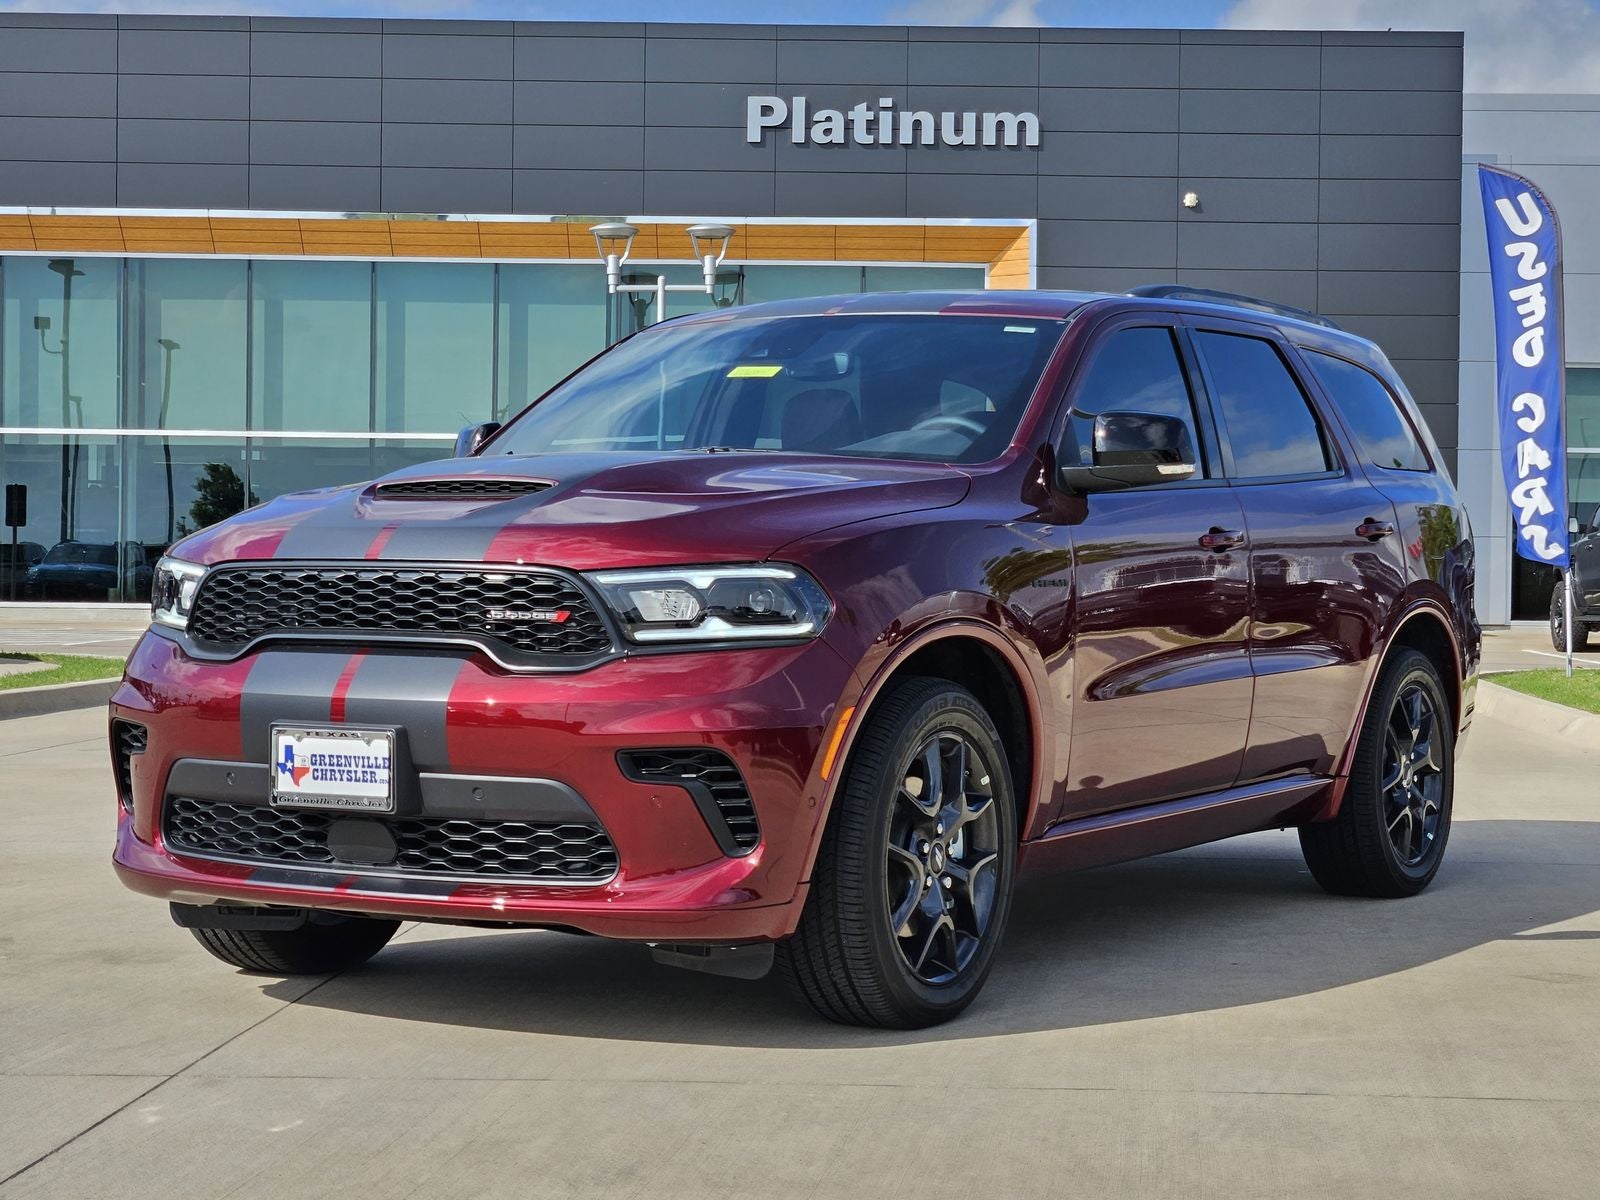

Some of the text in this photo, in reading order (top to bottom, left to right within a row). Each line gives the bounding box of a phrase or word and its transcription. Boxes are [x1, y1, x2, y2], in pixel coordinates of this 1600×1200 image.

[746, 95, 1040, 147] Platinum
[305, 731, 361, 739] TEXAS
[310, 753, 390, 769] GREENVILLE
[312, 769, 378, 784] CHRYSLER
